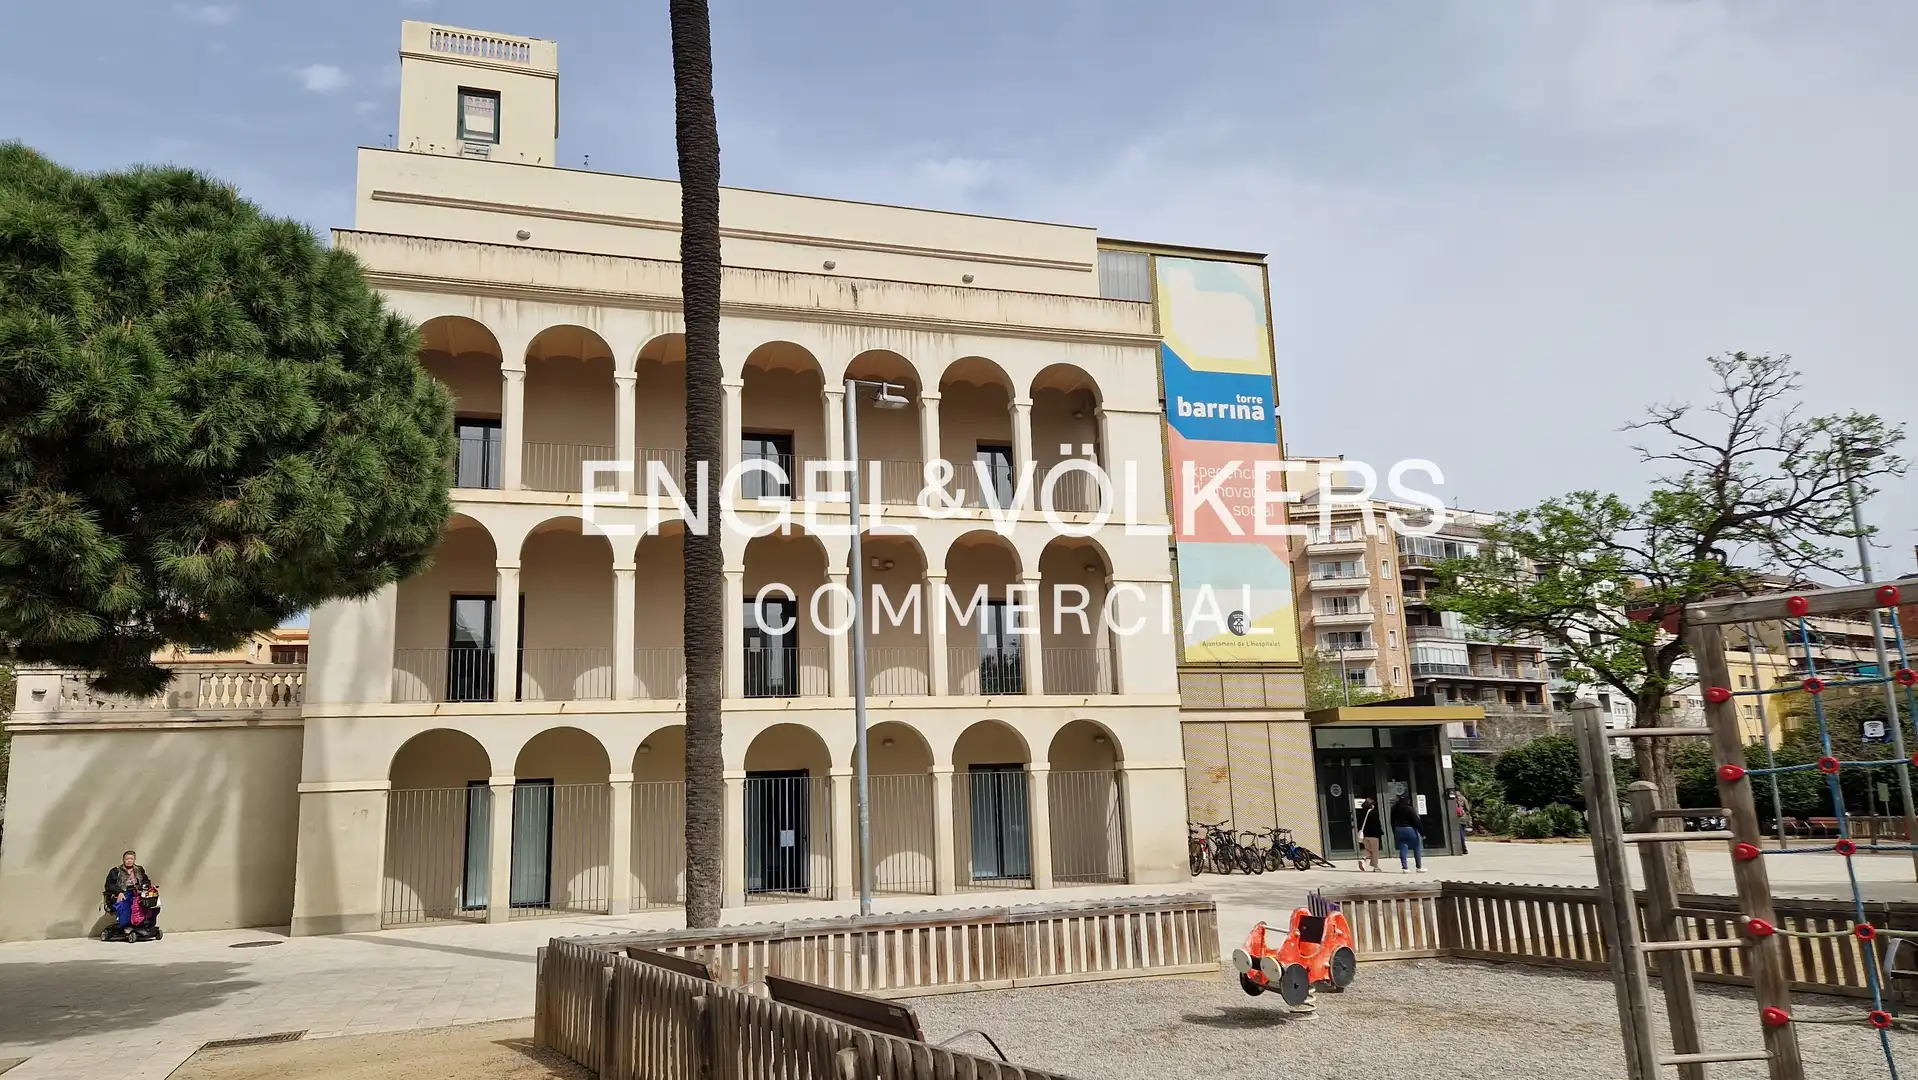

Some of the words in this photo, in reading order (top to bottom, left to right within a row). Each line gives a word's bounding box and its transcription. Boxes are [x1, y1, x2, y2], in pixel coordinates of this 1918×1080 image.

[1236, 394, 1263, 404] torre
[1177, 396, 1265, 420] barrina
[1232, 503, 1275, 517] socal
